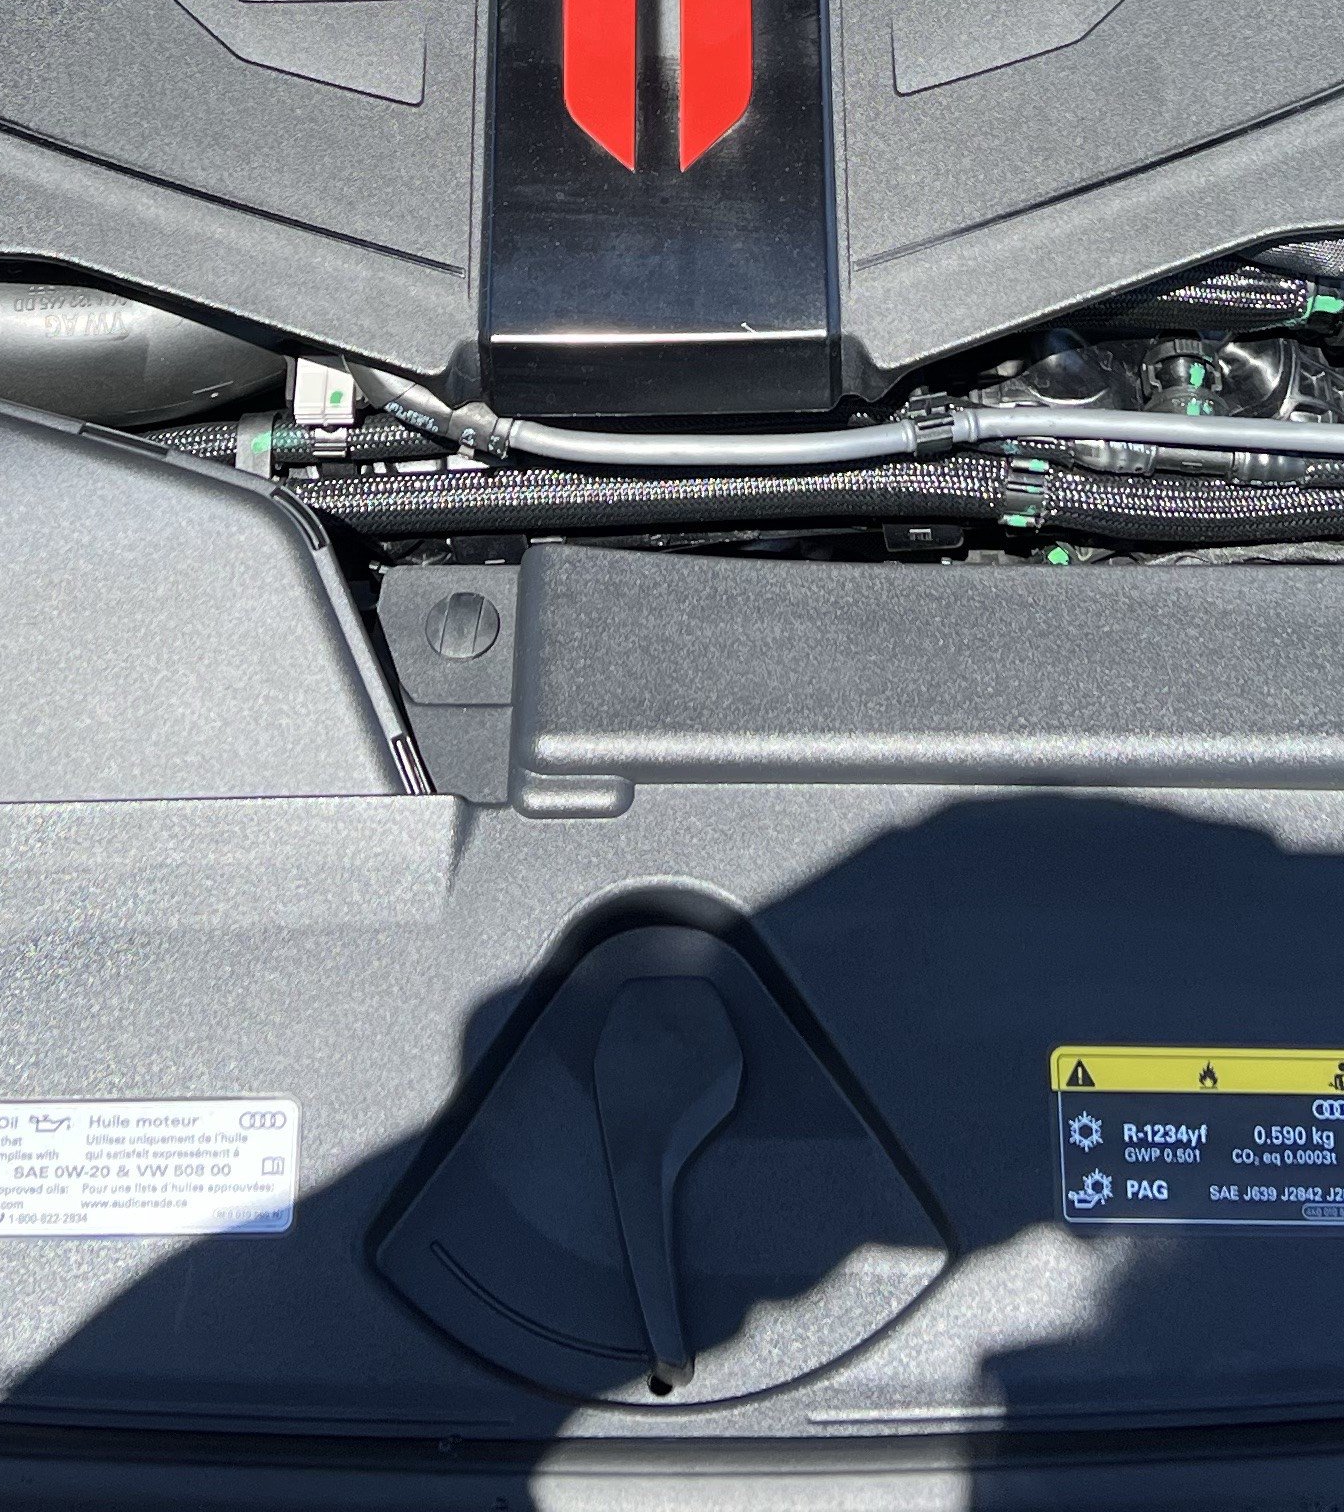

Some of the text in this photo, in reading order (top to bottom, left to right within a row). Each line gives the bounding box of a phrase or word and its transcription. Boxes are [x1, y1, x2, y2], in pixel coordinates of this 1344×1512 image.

[89, 1114, 200, 1129] Huile moteur
[0, 1135, 23, 1147] that
[86, 1133, 126, 1145] Utilisez
[129, 1133, 195, 1147] uniquement
[198, 1132, 212, 1144] de
[1123, 1123, 1335, 1149] R-1234yf 0.590 kg
[35, 1149, 60, 1160] with
[85, 1148, 104, 1161] qui
[106, 1147, 151, 1159] satisfait
[1124, 1147, 1201, 1163] GWP 0.501
[1262, 1151, 1281, 1167] eq
[1284, 1149, 1338, 1165] 0.0003t
[13, 1163, 232, 1179] SAE 0W-20 & VW 508 00
[82, 1182, 109, 1194] Pour
[111, 1183, 131, 1194] une
[134, 1182, 158, 1193] liste
[1126, 1179, 1169, 1200] PAG
[1209, 1185, 1240, 1201] SAE
[1243, 1185, 1278, 1202] J639
[1280, 1186, 1323, 1202] J2842
